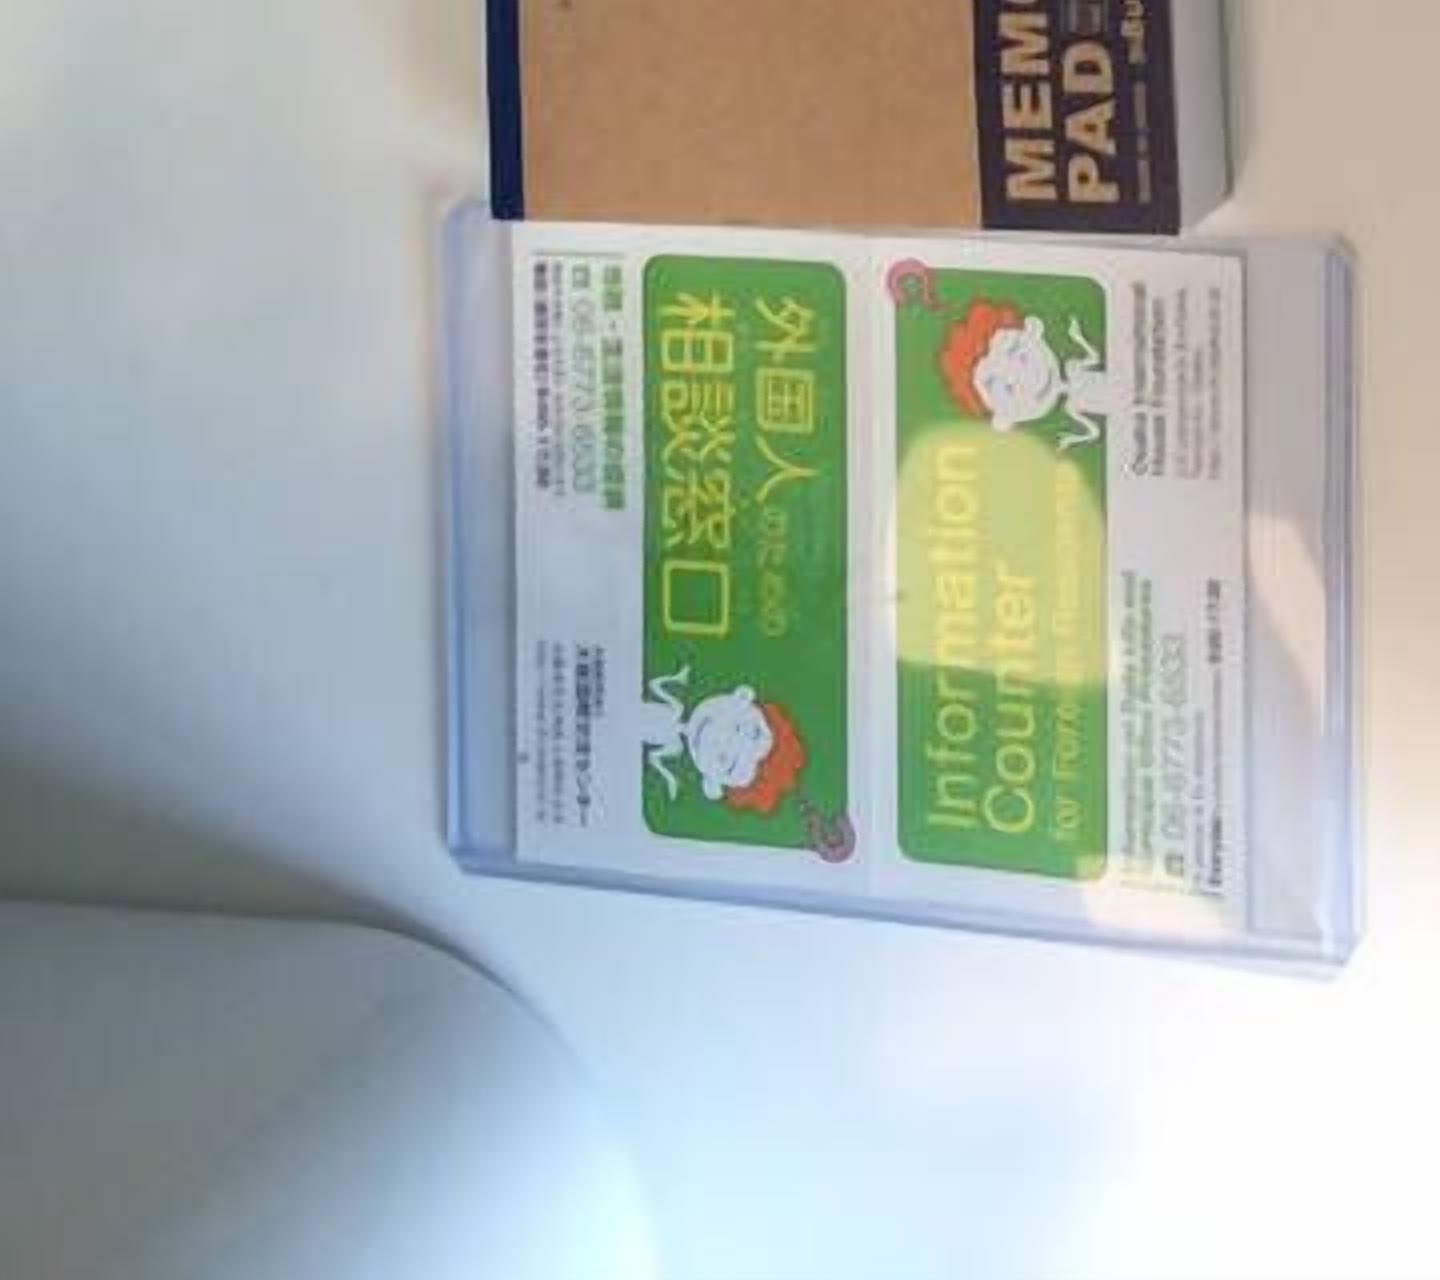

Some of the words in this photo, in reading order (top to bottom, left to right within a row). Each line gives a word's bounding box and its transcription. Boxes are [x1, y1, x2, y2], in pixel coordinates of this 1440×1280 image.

[1061, 40, 1121, 204] PAD
[656, 290, 738, 639] 相談窓口
[924, 444, 979, 832] Information
[983, 560, 1036, 834] Counter
